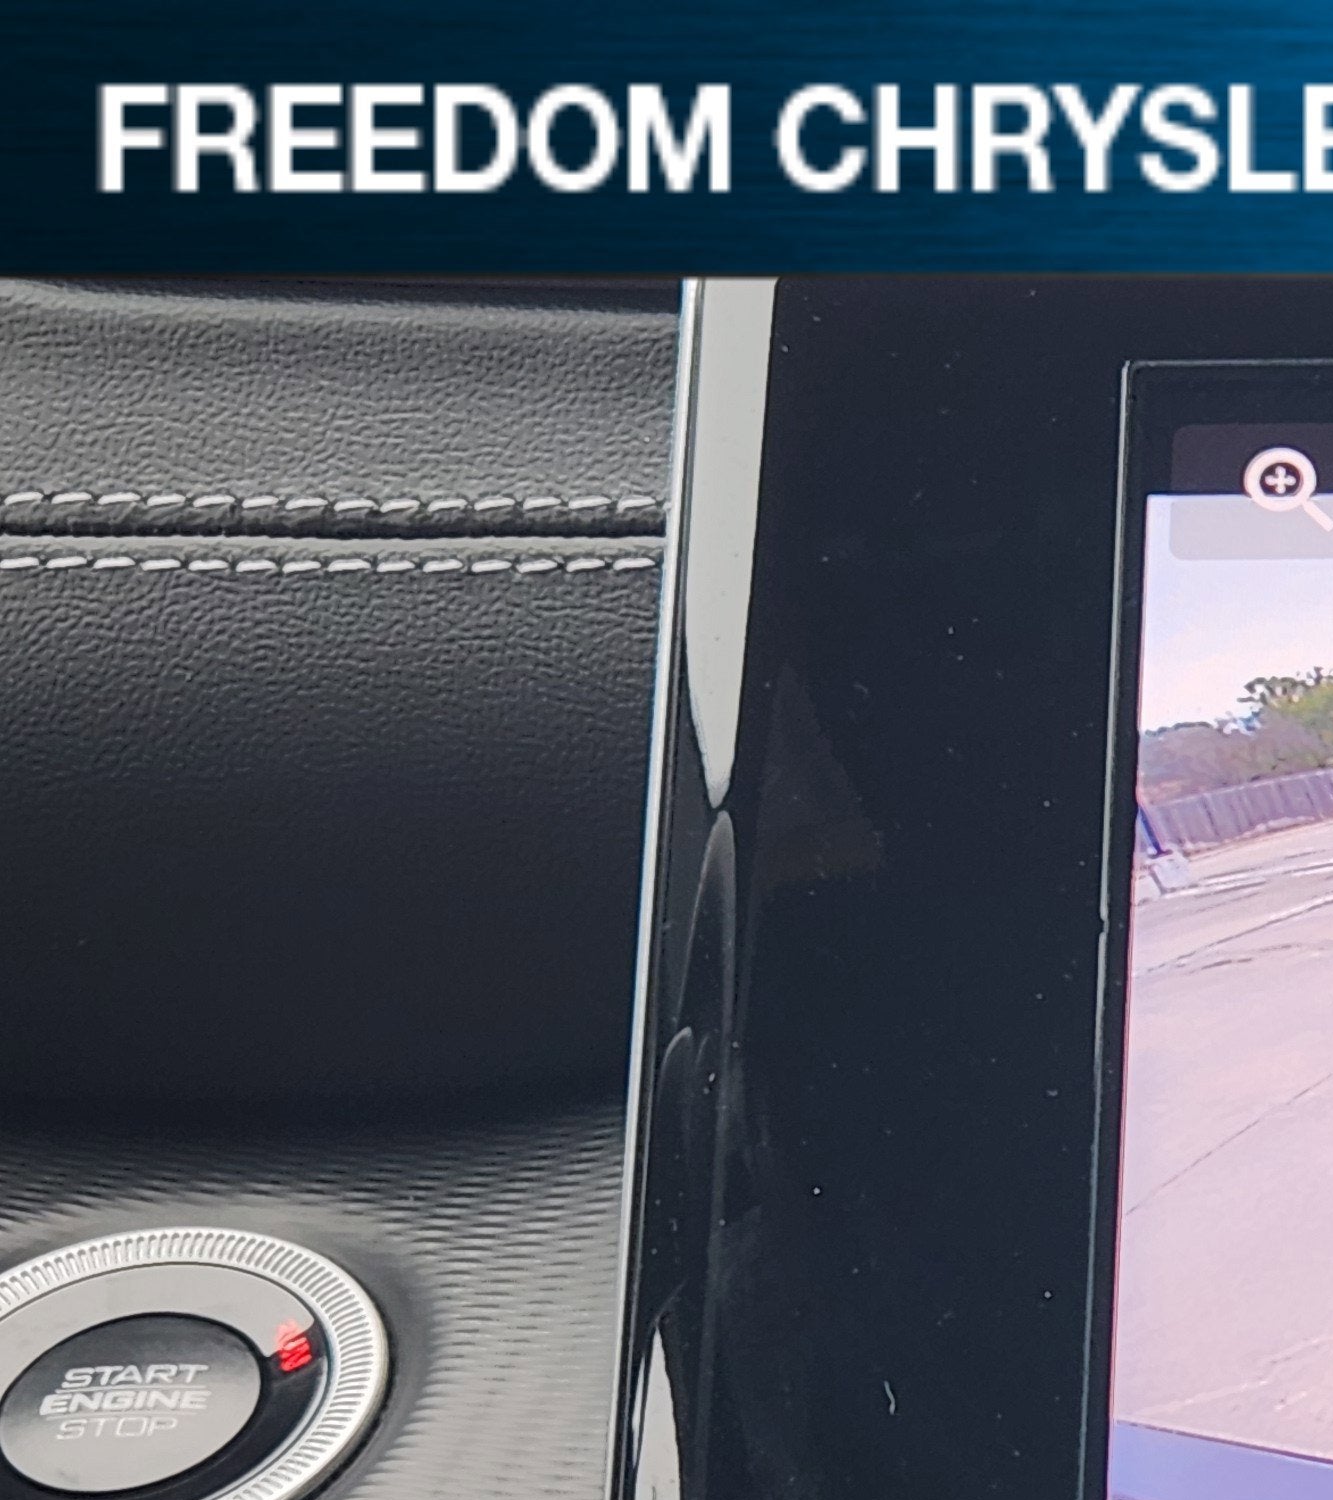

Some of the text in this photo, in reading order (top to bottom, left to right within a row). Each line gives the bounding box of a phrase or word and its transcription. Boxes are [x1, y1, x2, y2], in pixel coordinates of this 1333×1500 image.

[61, 1364, 209, 1387] START
[39, 1390, 212, 1415] ENGINE
[56, 1416, 179, 1440] STOP
